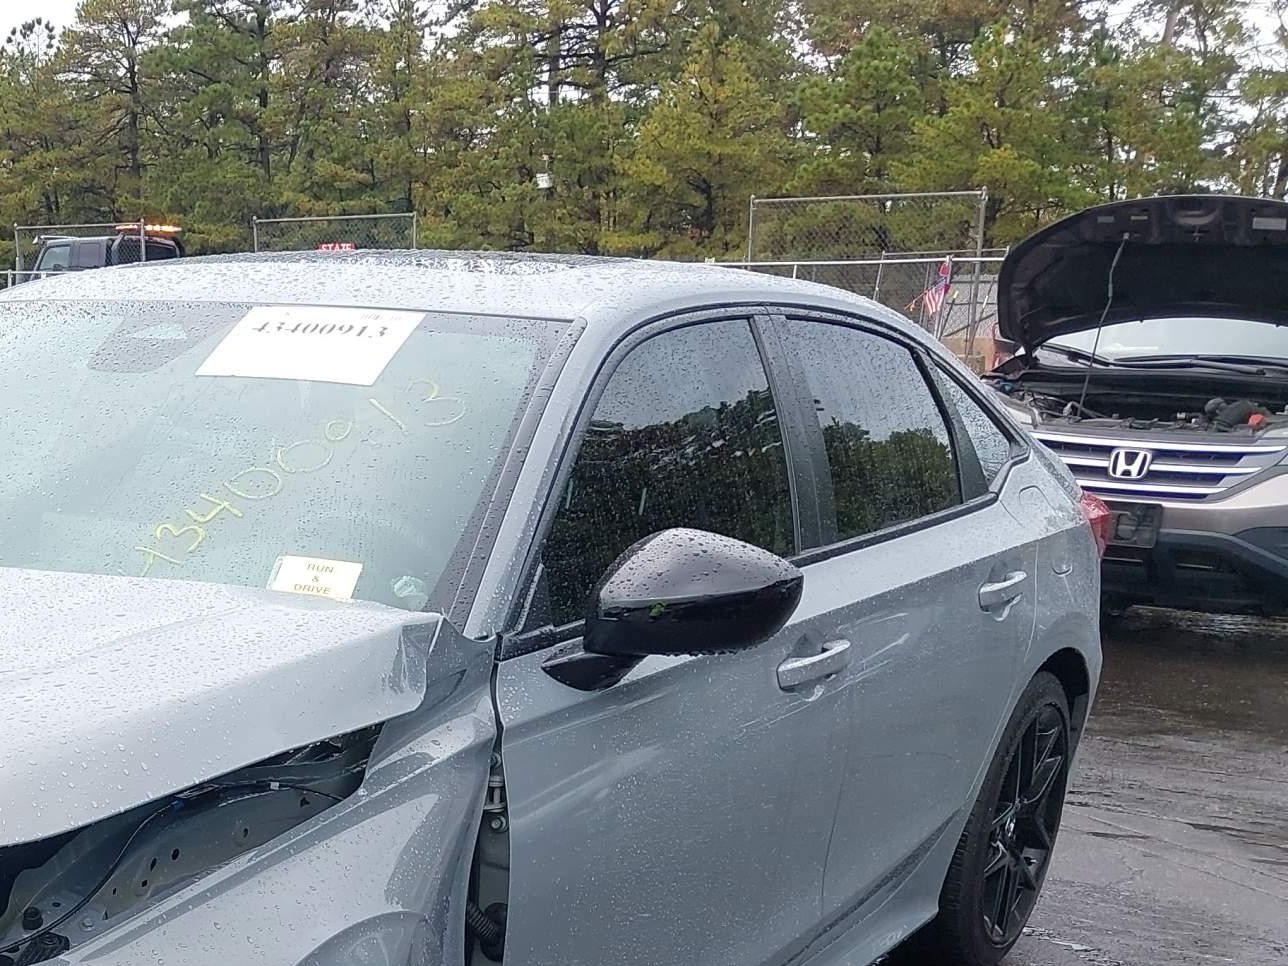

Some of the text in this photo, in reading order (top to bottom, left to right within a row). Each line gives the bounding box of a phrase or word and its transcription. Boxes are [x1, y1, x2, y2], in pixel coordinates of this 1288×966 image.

[251, 320, 390, 338] 43400913
[306, 563, 335, 574] RUN
[311, 575, 320, 584] &
[293, 583, 331, 595] DRIVE
